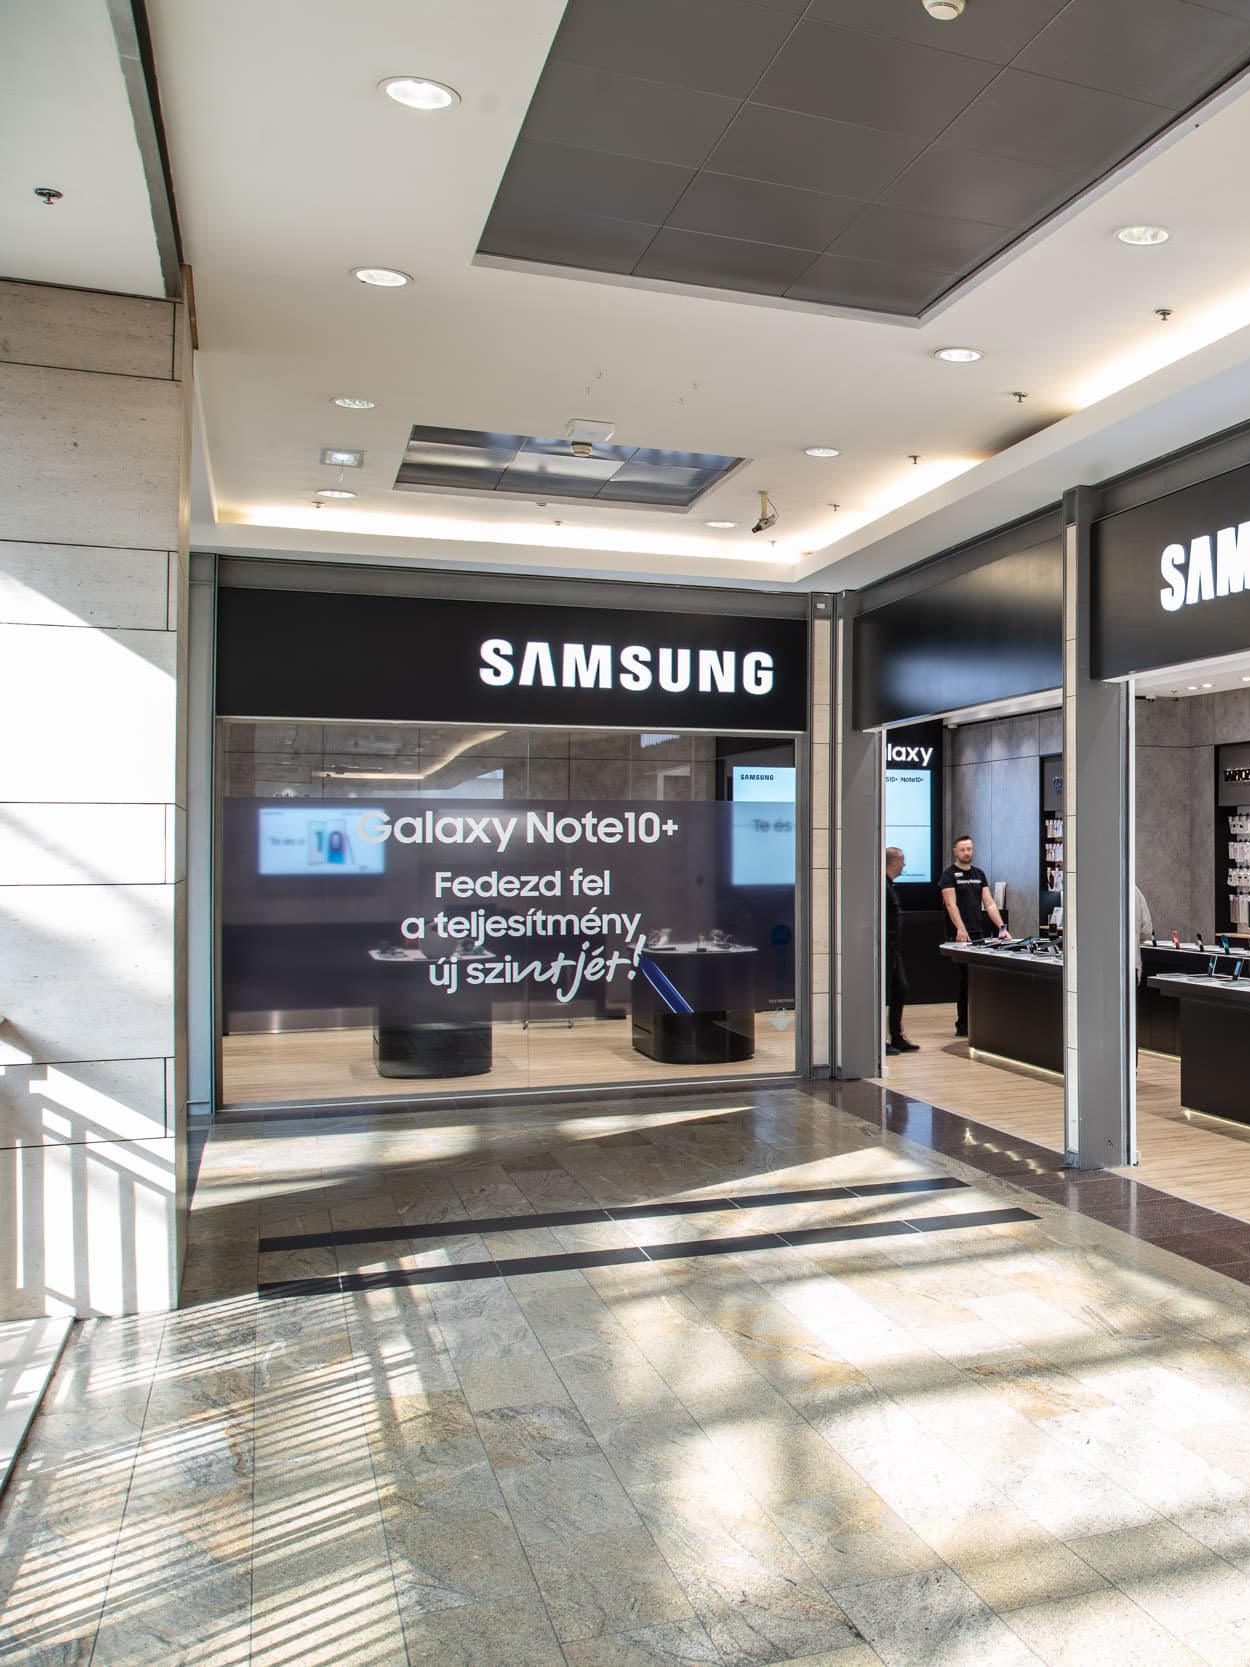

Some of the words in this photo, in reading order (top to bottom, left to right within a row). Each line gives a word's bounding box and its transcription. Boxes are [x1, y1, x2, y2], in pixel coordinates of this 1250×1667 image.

[479, 638, 774, 696] SAMSUNG
[358, 810, 518, 853] Galaxy
[526, 810, 679, 844] Note10+
[435, 870, 561, 898] Fedezd
[570, 867, 611, 896] fel
[401, 916, 425, 939] a
[433, 906, 642, 946] teljesítmény
[429, 956, 458, 994] új
